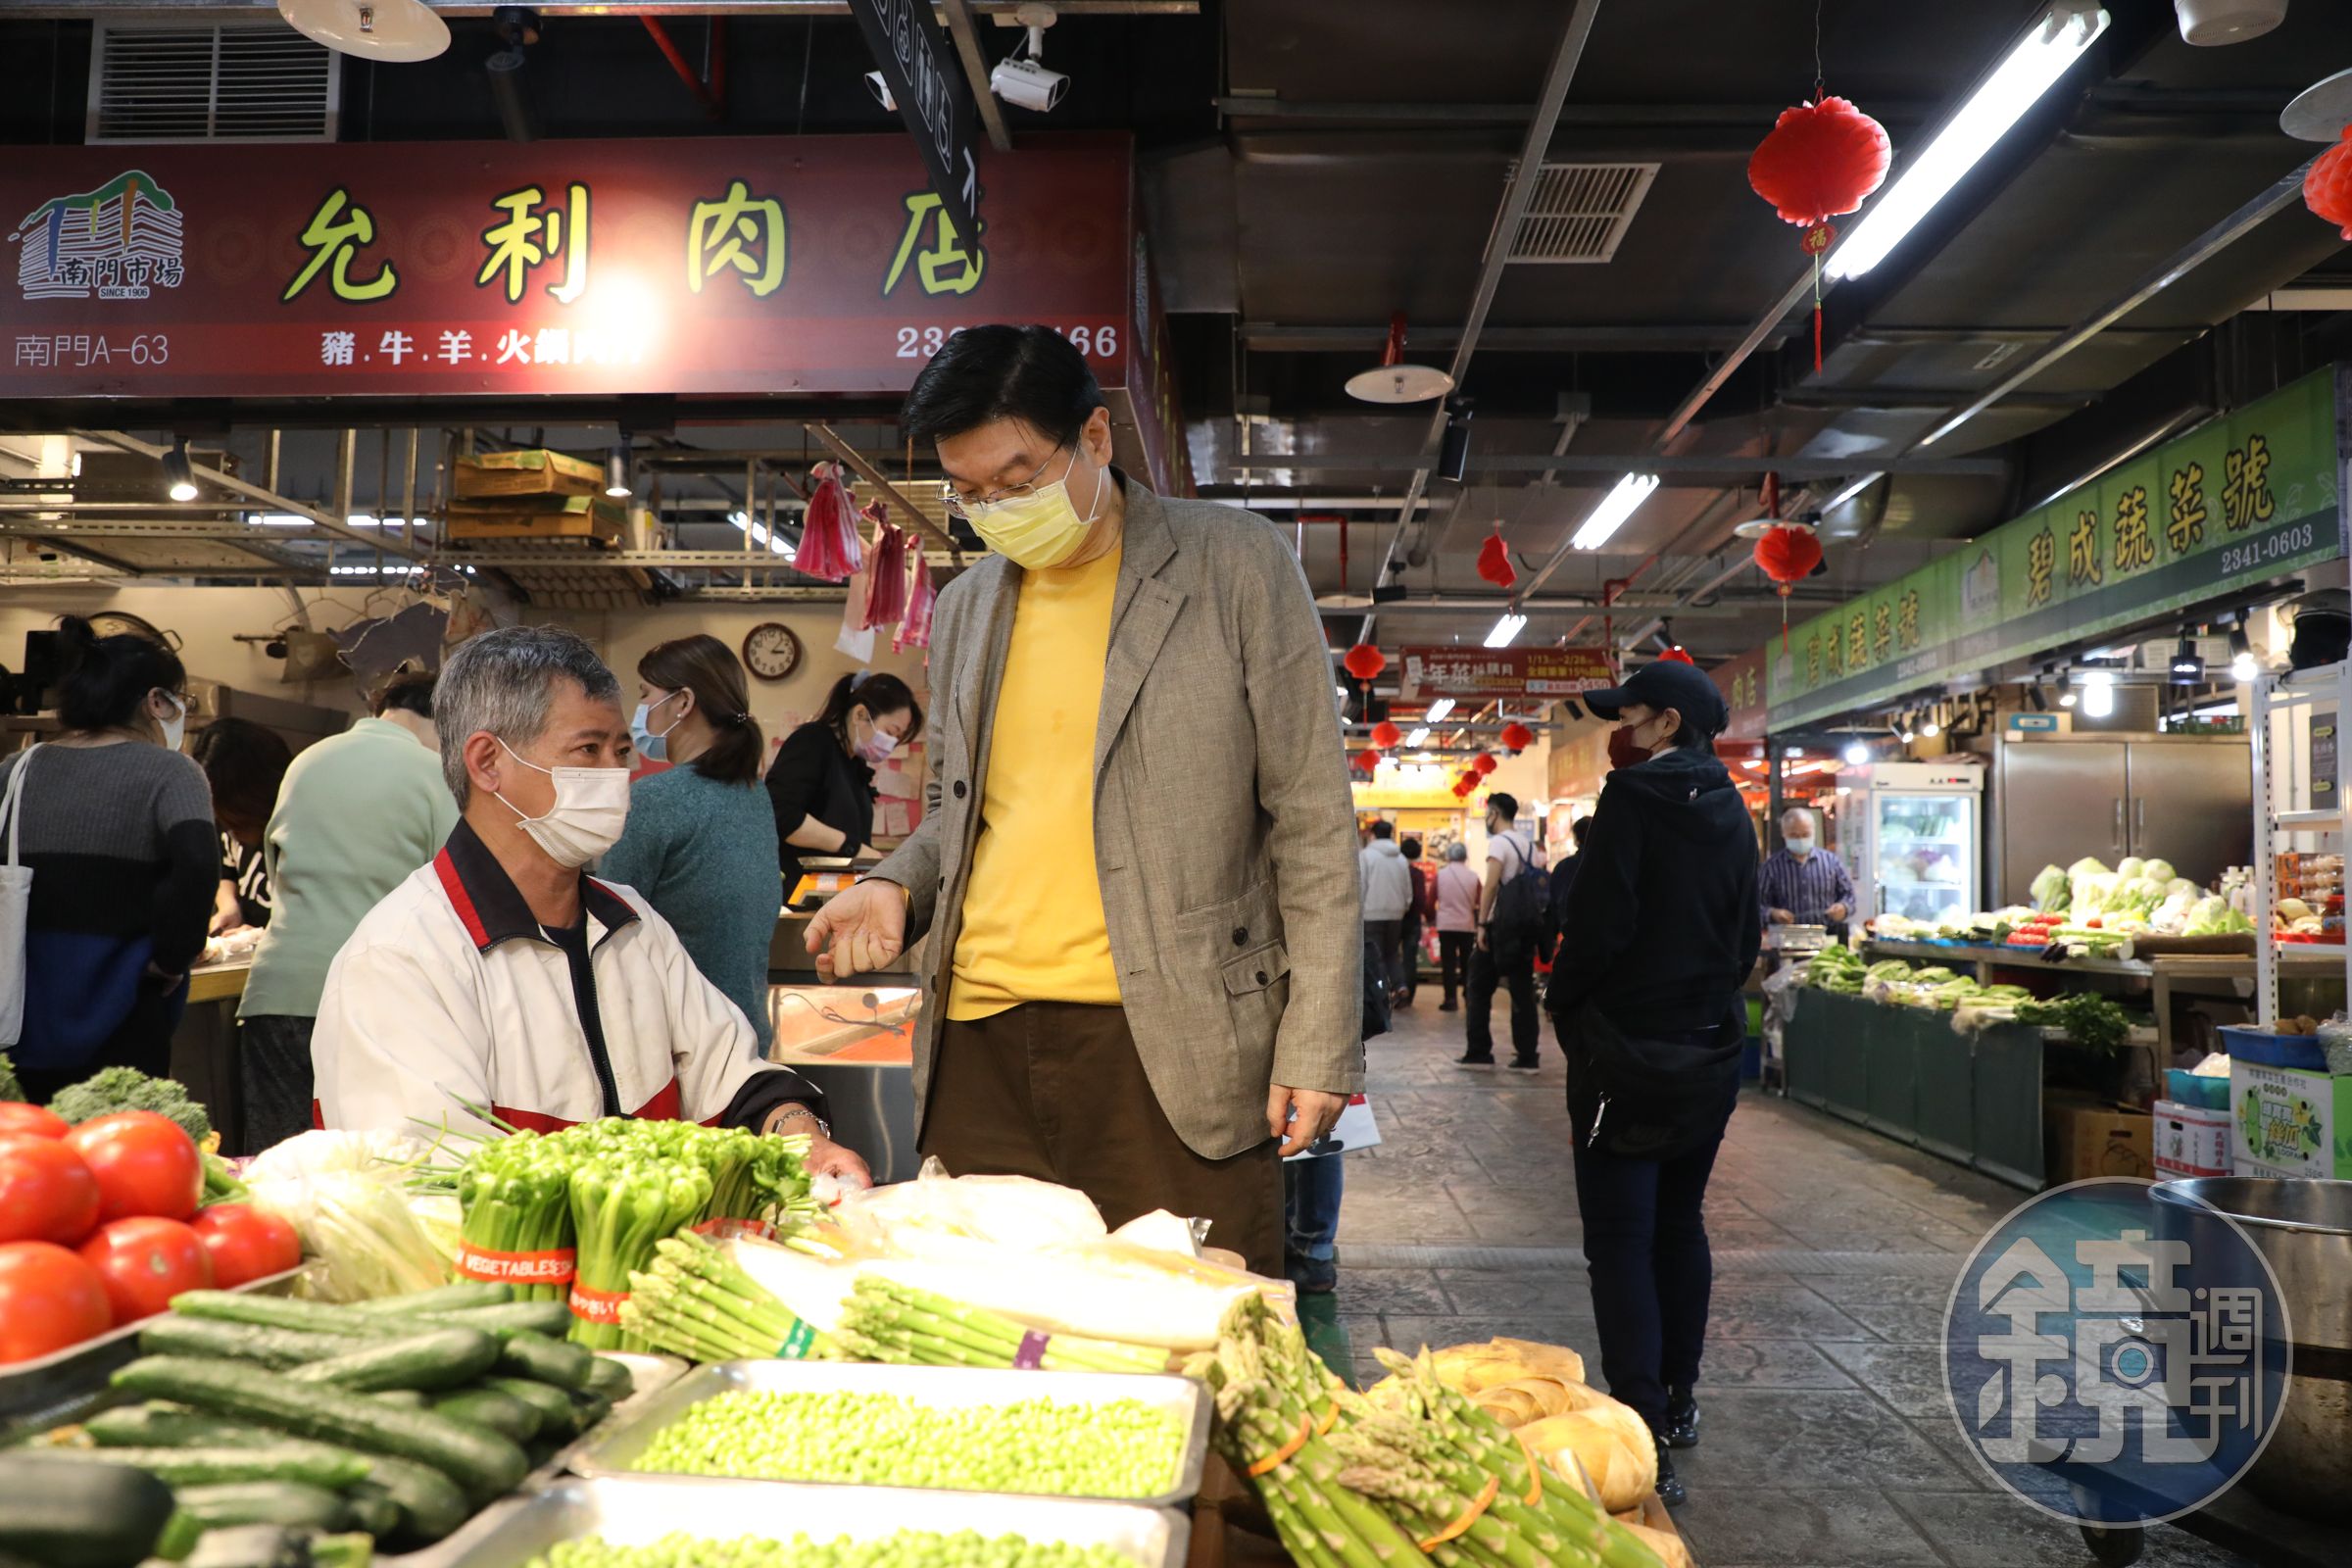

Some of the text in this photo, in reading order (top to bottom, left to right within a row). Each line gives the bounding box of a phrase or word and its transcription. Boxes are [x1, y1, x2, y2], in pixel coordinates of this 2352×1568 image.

[281, 181, 985, 304] 允利肉店
[61, 258, 183, 287] 南門市場
[100, 287, 147, 298] SINCE 1906
[2027, 434, 2276, 610] 碧成蔬菜號
[2222, 522, 2313, 574] 2341-0603
[466, 1254, 558, 1277] VEGETABLES
